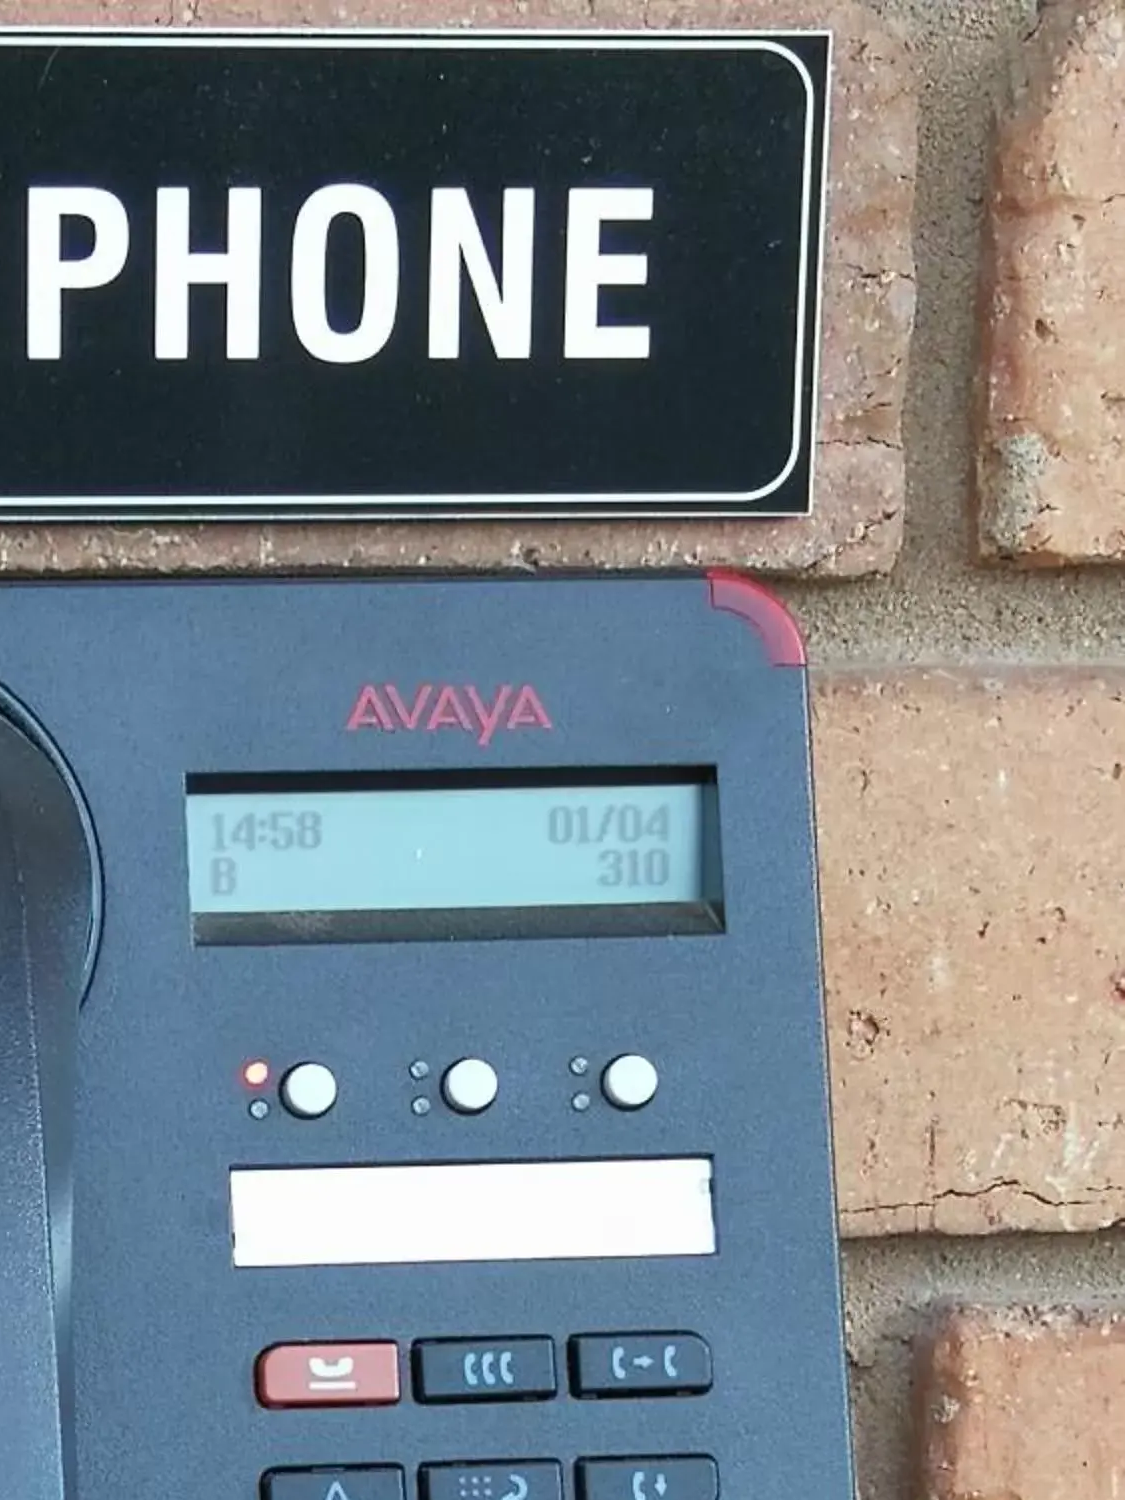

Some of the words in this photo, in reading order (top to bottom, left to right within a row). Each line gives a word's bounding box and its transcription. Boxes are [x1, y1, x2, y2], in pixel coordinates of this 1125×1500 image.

[25, 182, 655, 364] PHONE
[346, 684, 553, 745] AVAYA
[211, 811, 323, 852] 14:58
[547, 804, 672, 845] 01/04
[599, 850, 671, 888] 310
